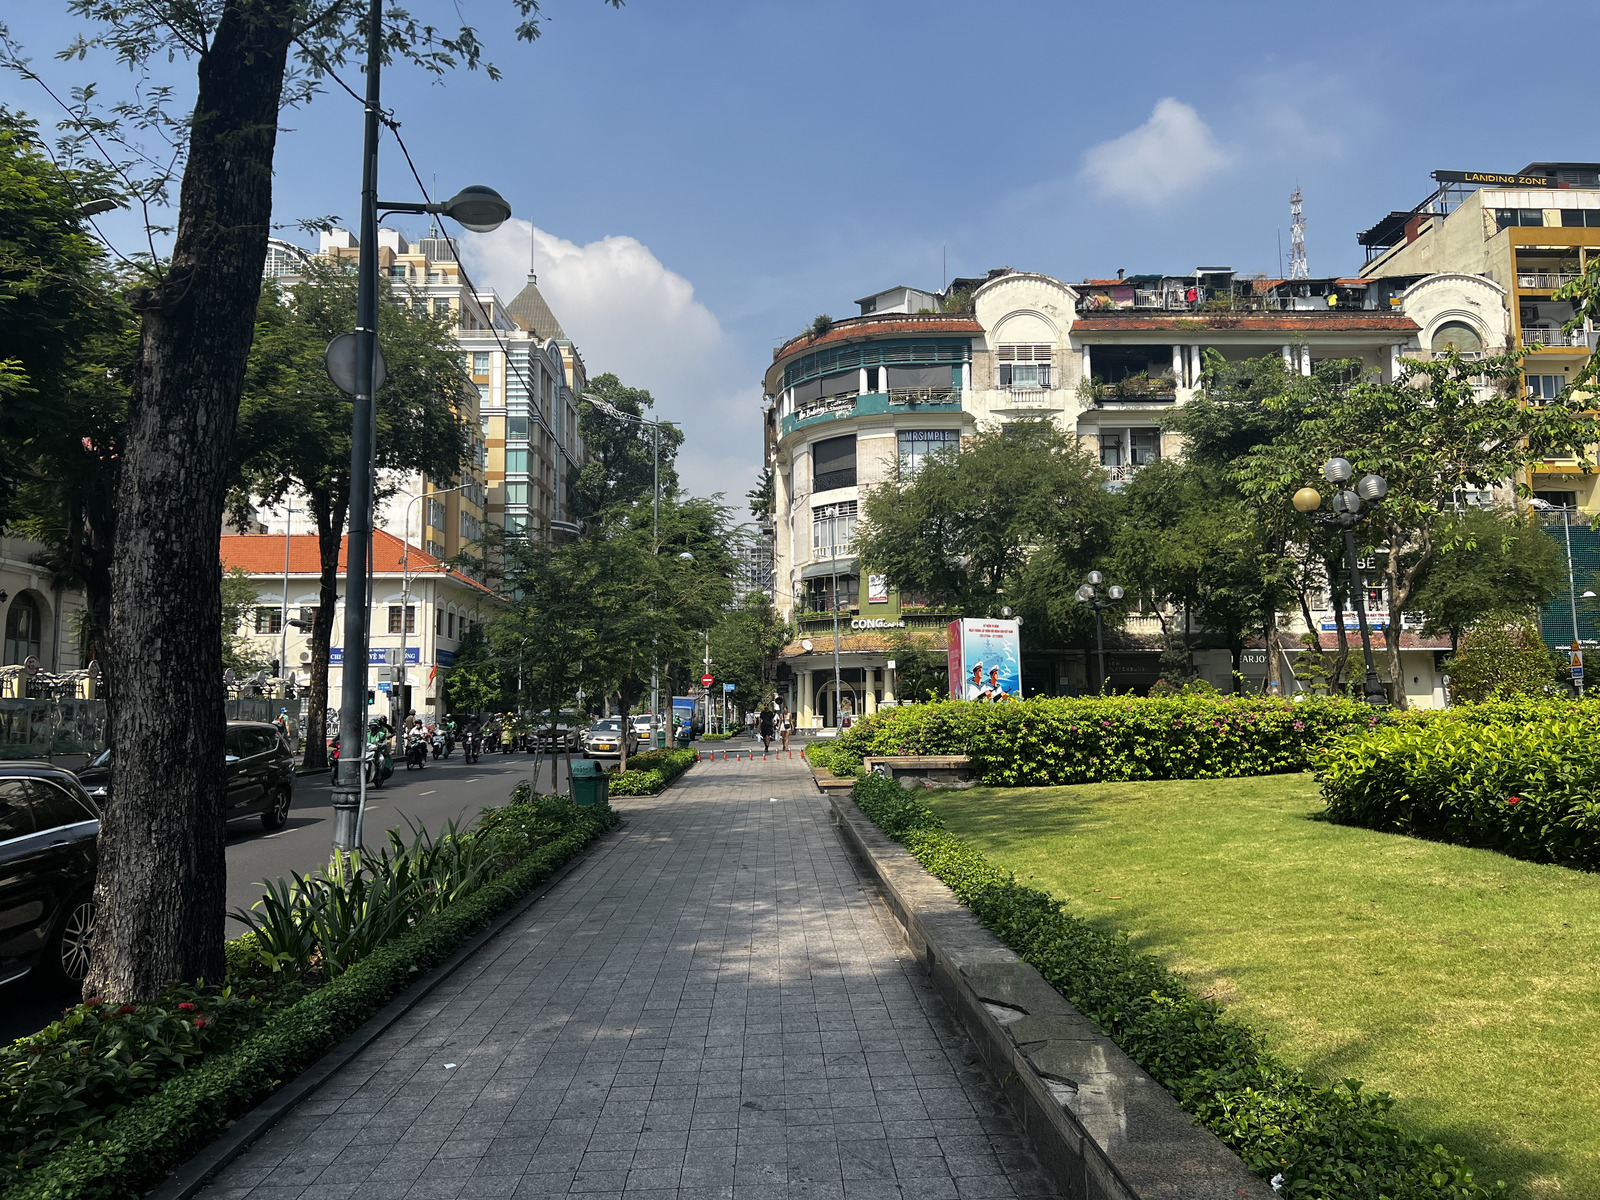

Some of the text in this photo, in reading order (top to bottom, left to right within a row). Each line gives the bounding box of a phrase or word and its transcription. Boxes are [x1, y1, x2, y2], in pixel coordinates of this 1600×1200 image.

[1464, 173, 1547, 185] LANDING ZONE
[904, 431, 949, 441] MRSIMPLE
[851, 617, 884, 631] CỘNG
